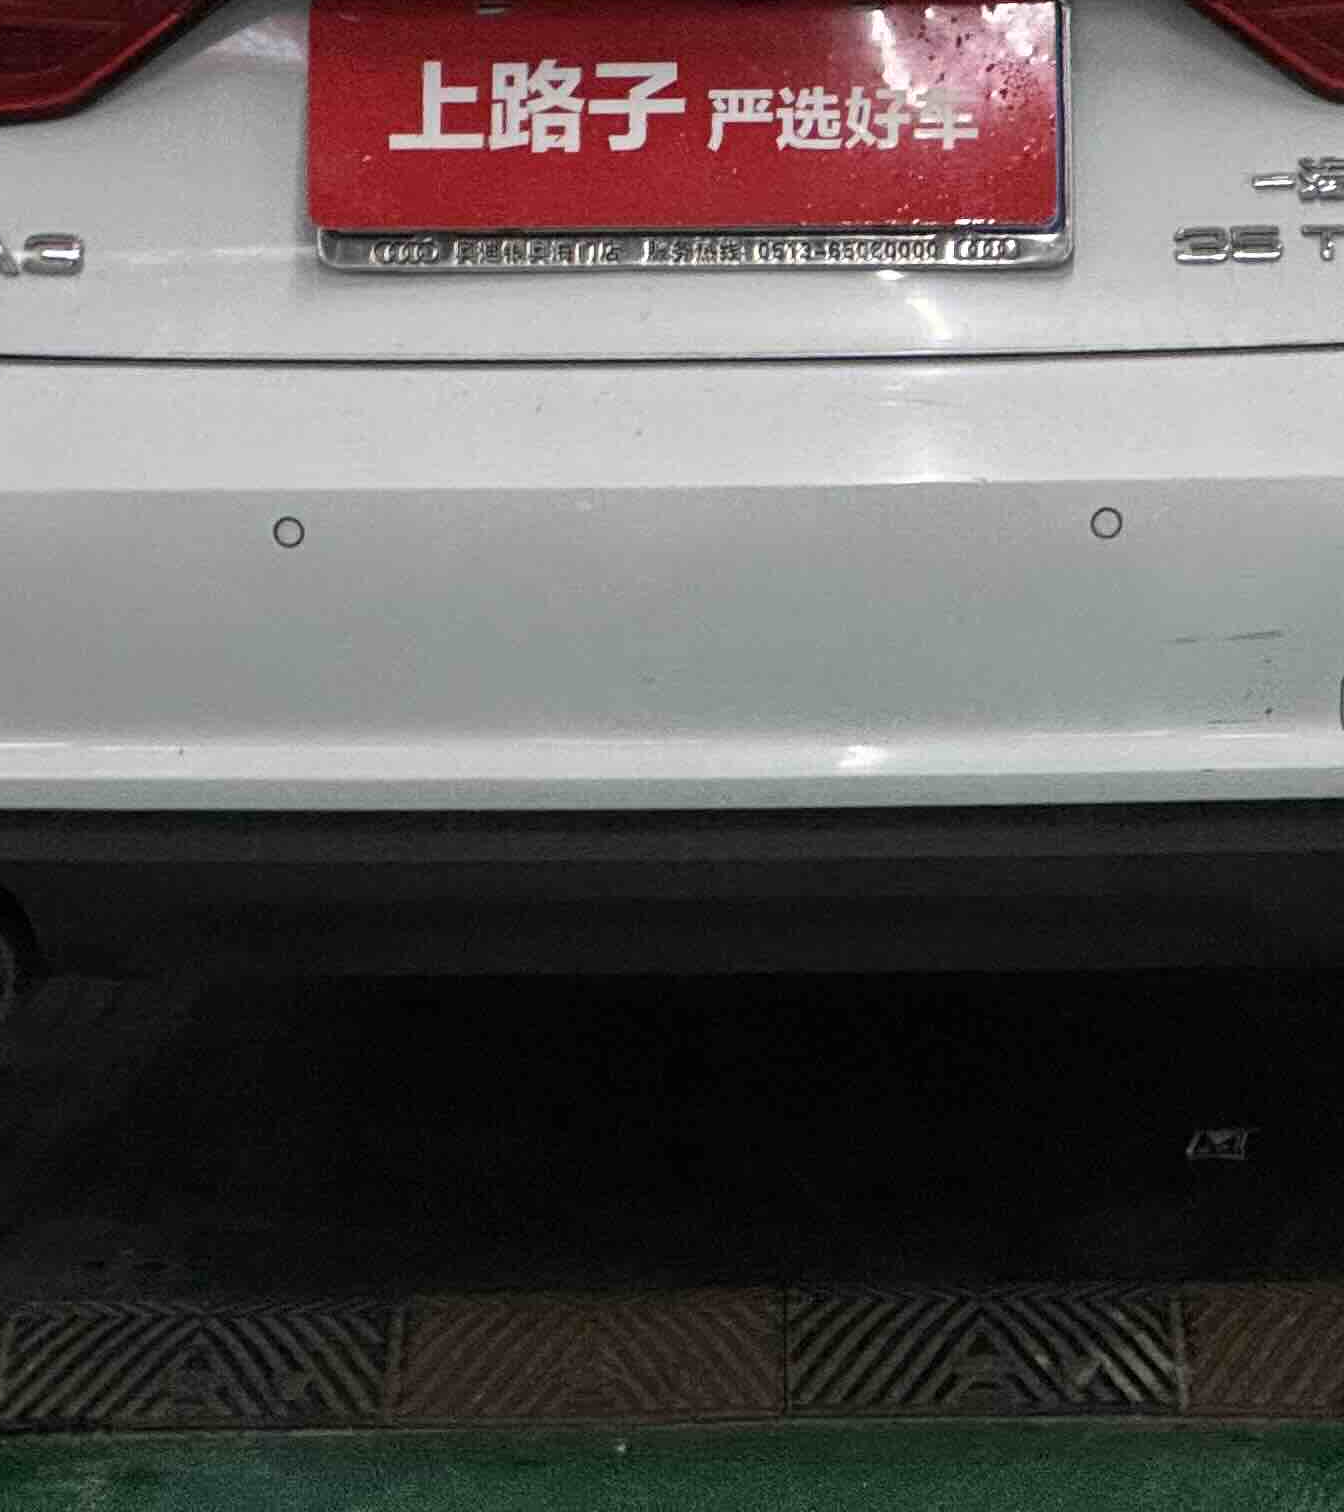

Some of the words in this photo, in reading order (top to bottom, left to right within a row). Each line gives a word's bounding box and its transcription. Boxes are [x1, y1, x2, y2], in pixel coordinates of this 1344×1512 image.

[388, 60, 687, 154] 上路子
[706, 86, 981, 151] 严选好车
[1172, 224, 1285, 266] 35
